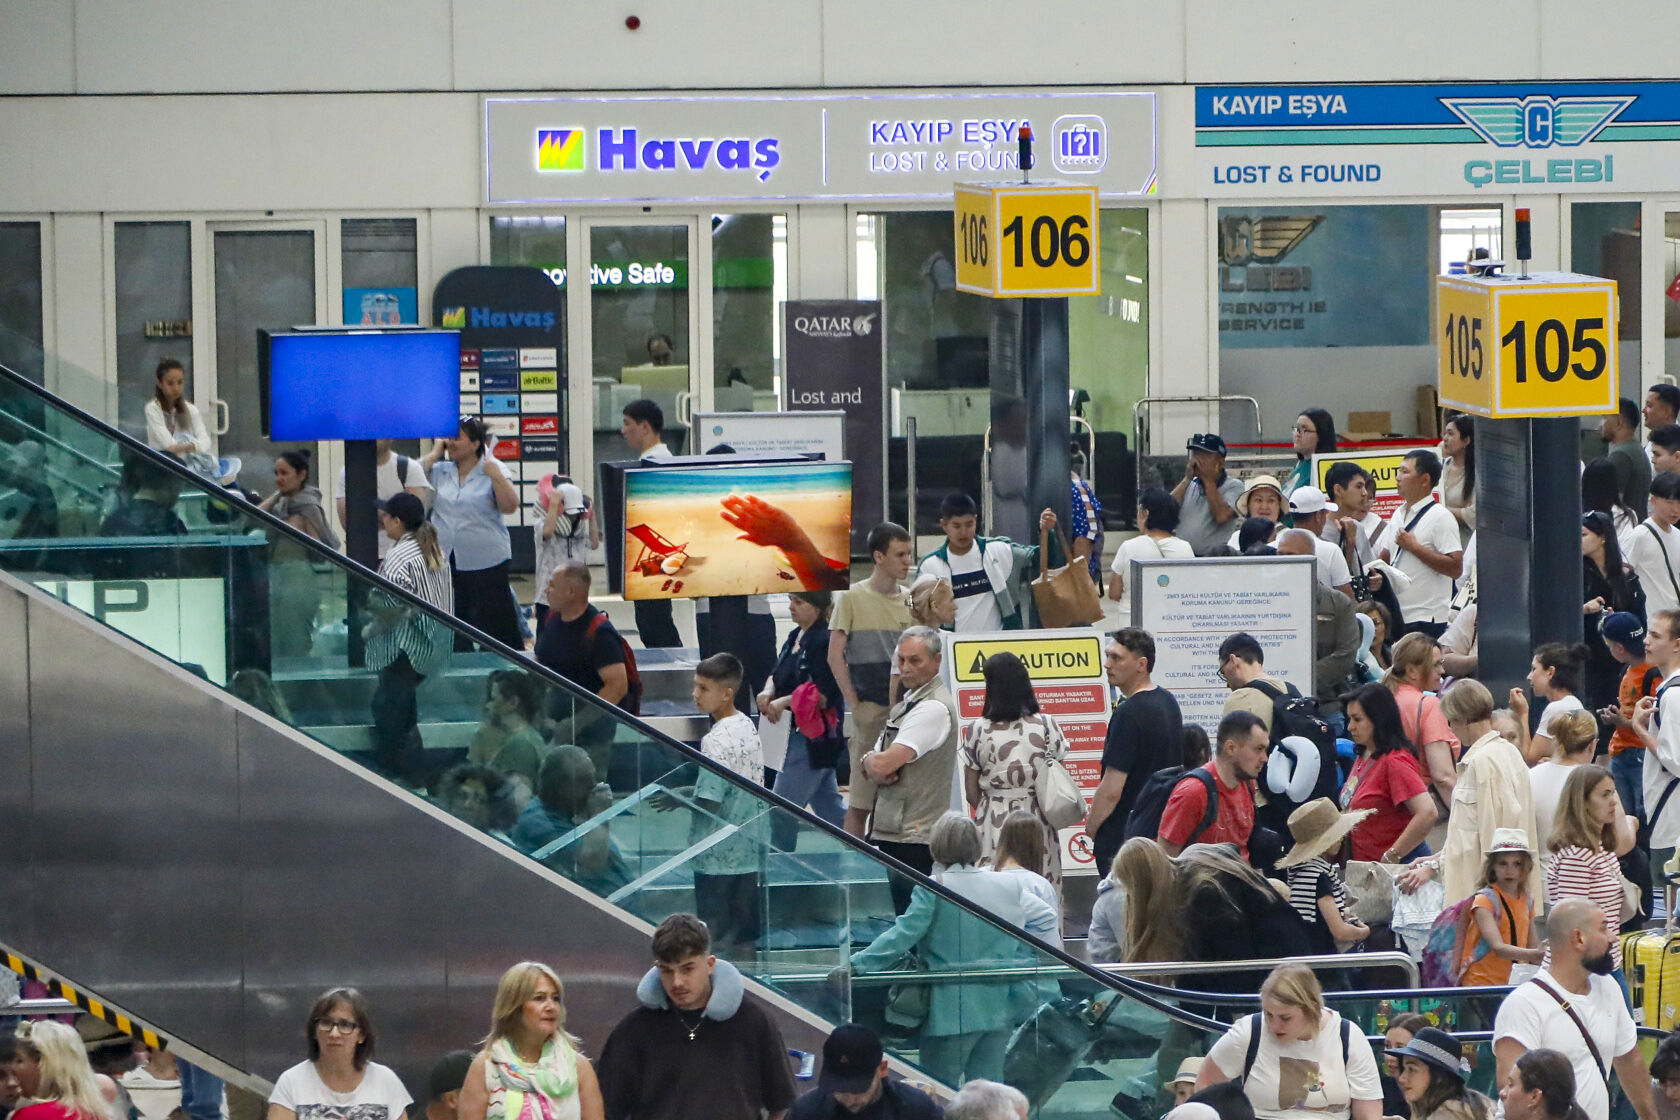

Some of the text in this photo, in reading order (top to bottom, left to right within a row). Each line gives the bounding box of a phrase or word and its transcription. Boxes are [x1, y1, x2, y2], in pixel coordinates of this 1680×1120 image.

[1213, 95, 1347, 119] KAYIP EŞYA
[870, 120, 953, 145] KAYIP
[598, 128, 780, 182] Havaş
[869, 152, 926, 172] LOST
[934, 151, 950, 171] &
[1214, 164, 1381, 184] LOST & FOUND
[1464, 154, 1613, 188] ÇELEBİ
[961, 211, 988, 267] 106
[1003, 214, 1090, 268] 106
[628, 262, 675, 285] Safe
[471, 307, 555, 332] Havaş
[795, 316, 851, 334] QATAR
[1446, 313, 1483, 380] 105
[1502, 317, 1607, 383] 105
[792, 387, 862, 404] Lost and
[1019, 652, 1090, 669] AUTION
